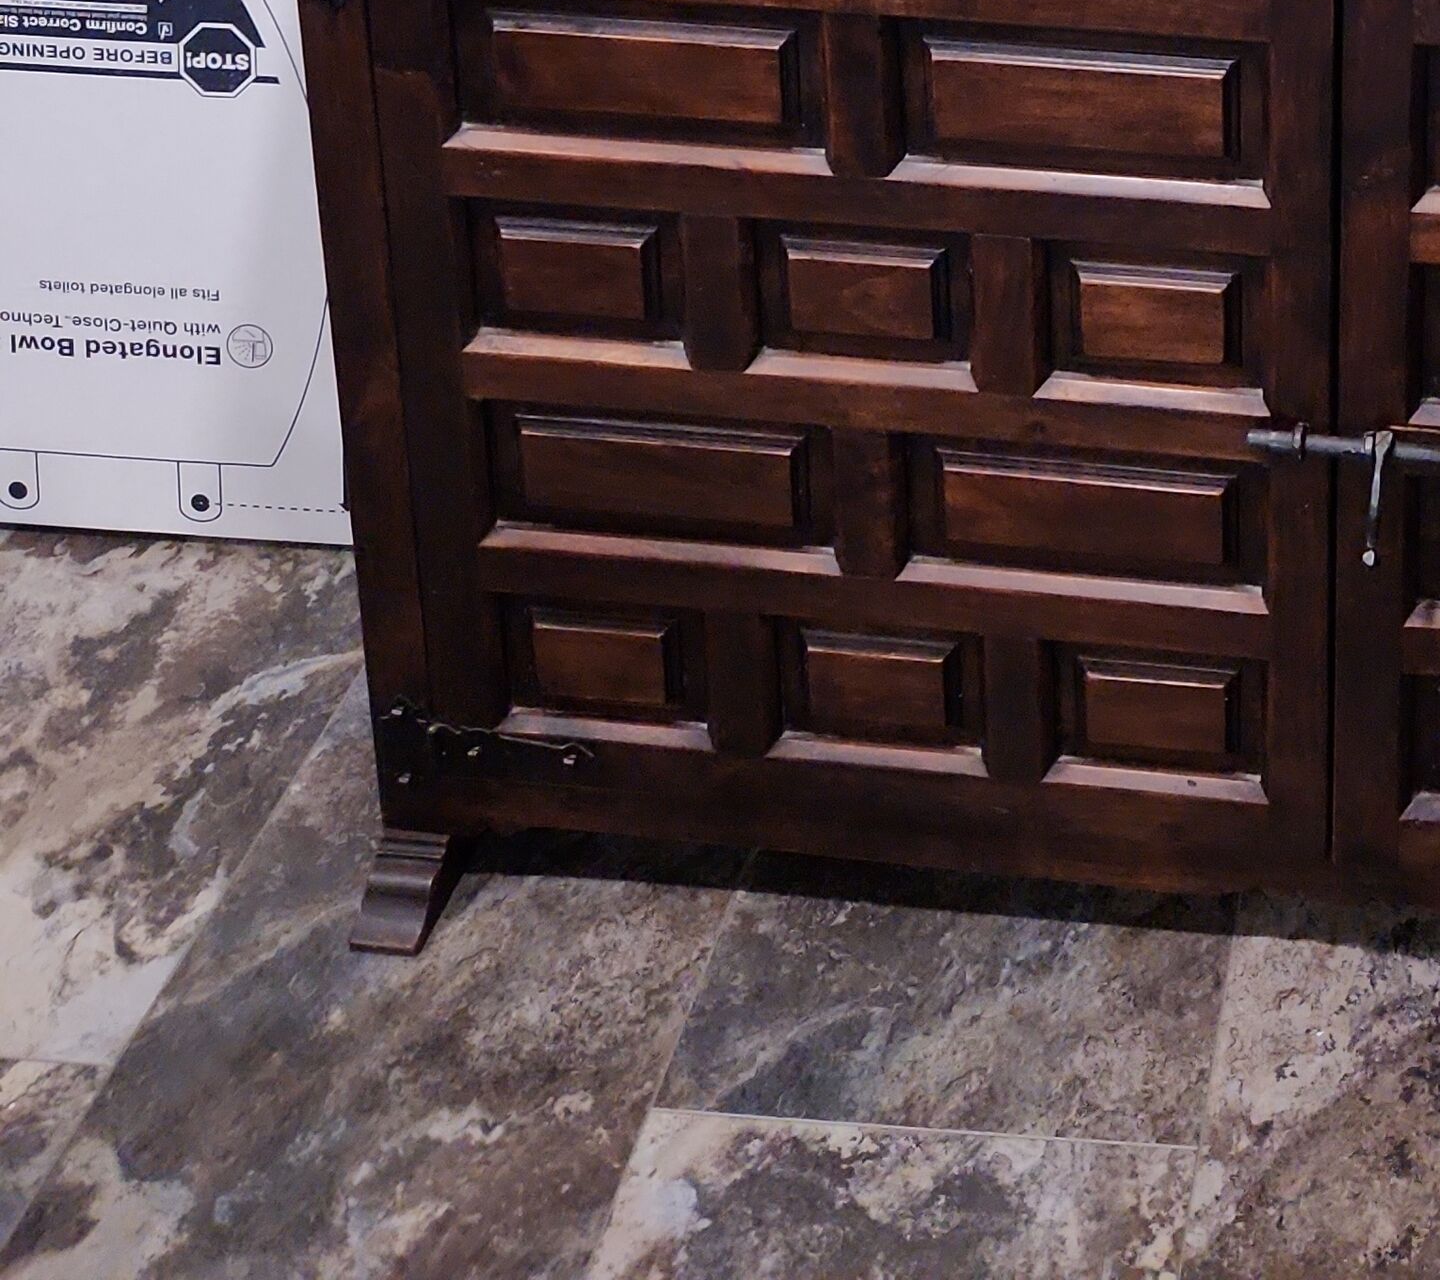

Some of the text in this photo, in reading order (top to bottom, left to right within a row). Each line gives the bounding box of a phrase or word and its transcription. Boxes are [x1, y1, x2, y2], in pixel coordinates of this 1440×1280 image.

[23, 16, 82, 32] Correct
[86, 18, 148, 35] Confirm
[93, 46, 173, 65] BEFORE
[185, 51, 250, 71] STOP!
[39, 279, 220, 302] Fits all elongated toilets
[183, 320, 222, 336] with
[10, 334, 222, 366] Elongated Bowl
